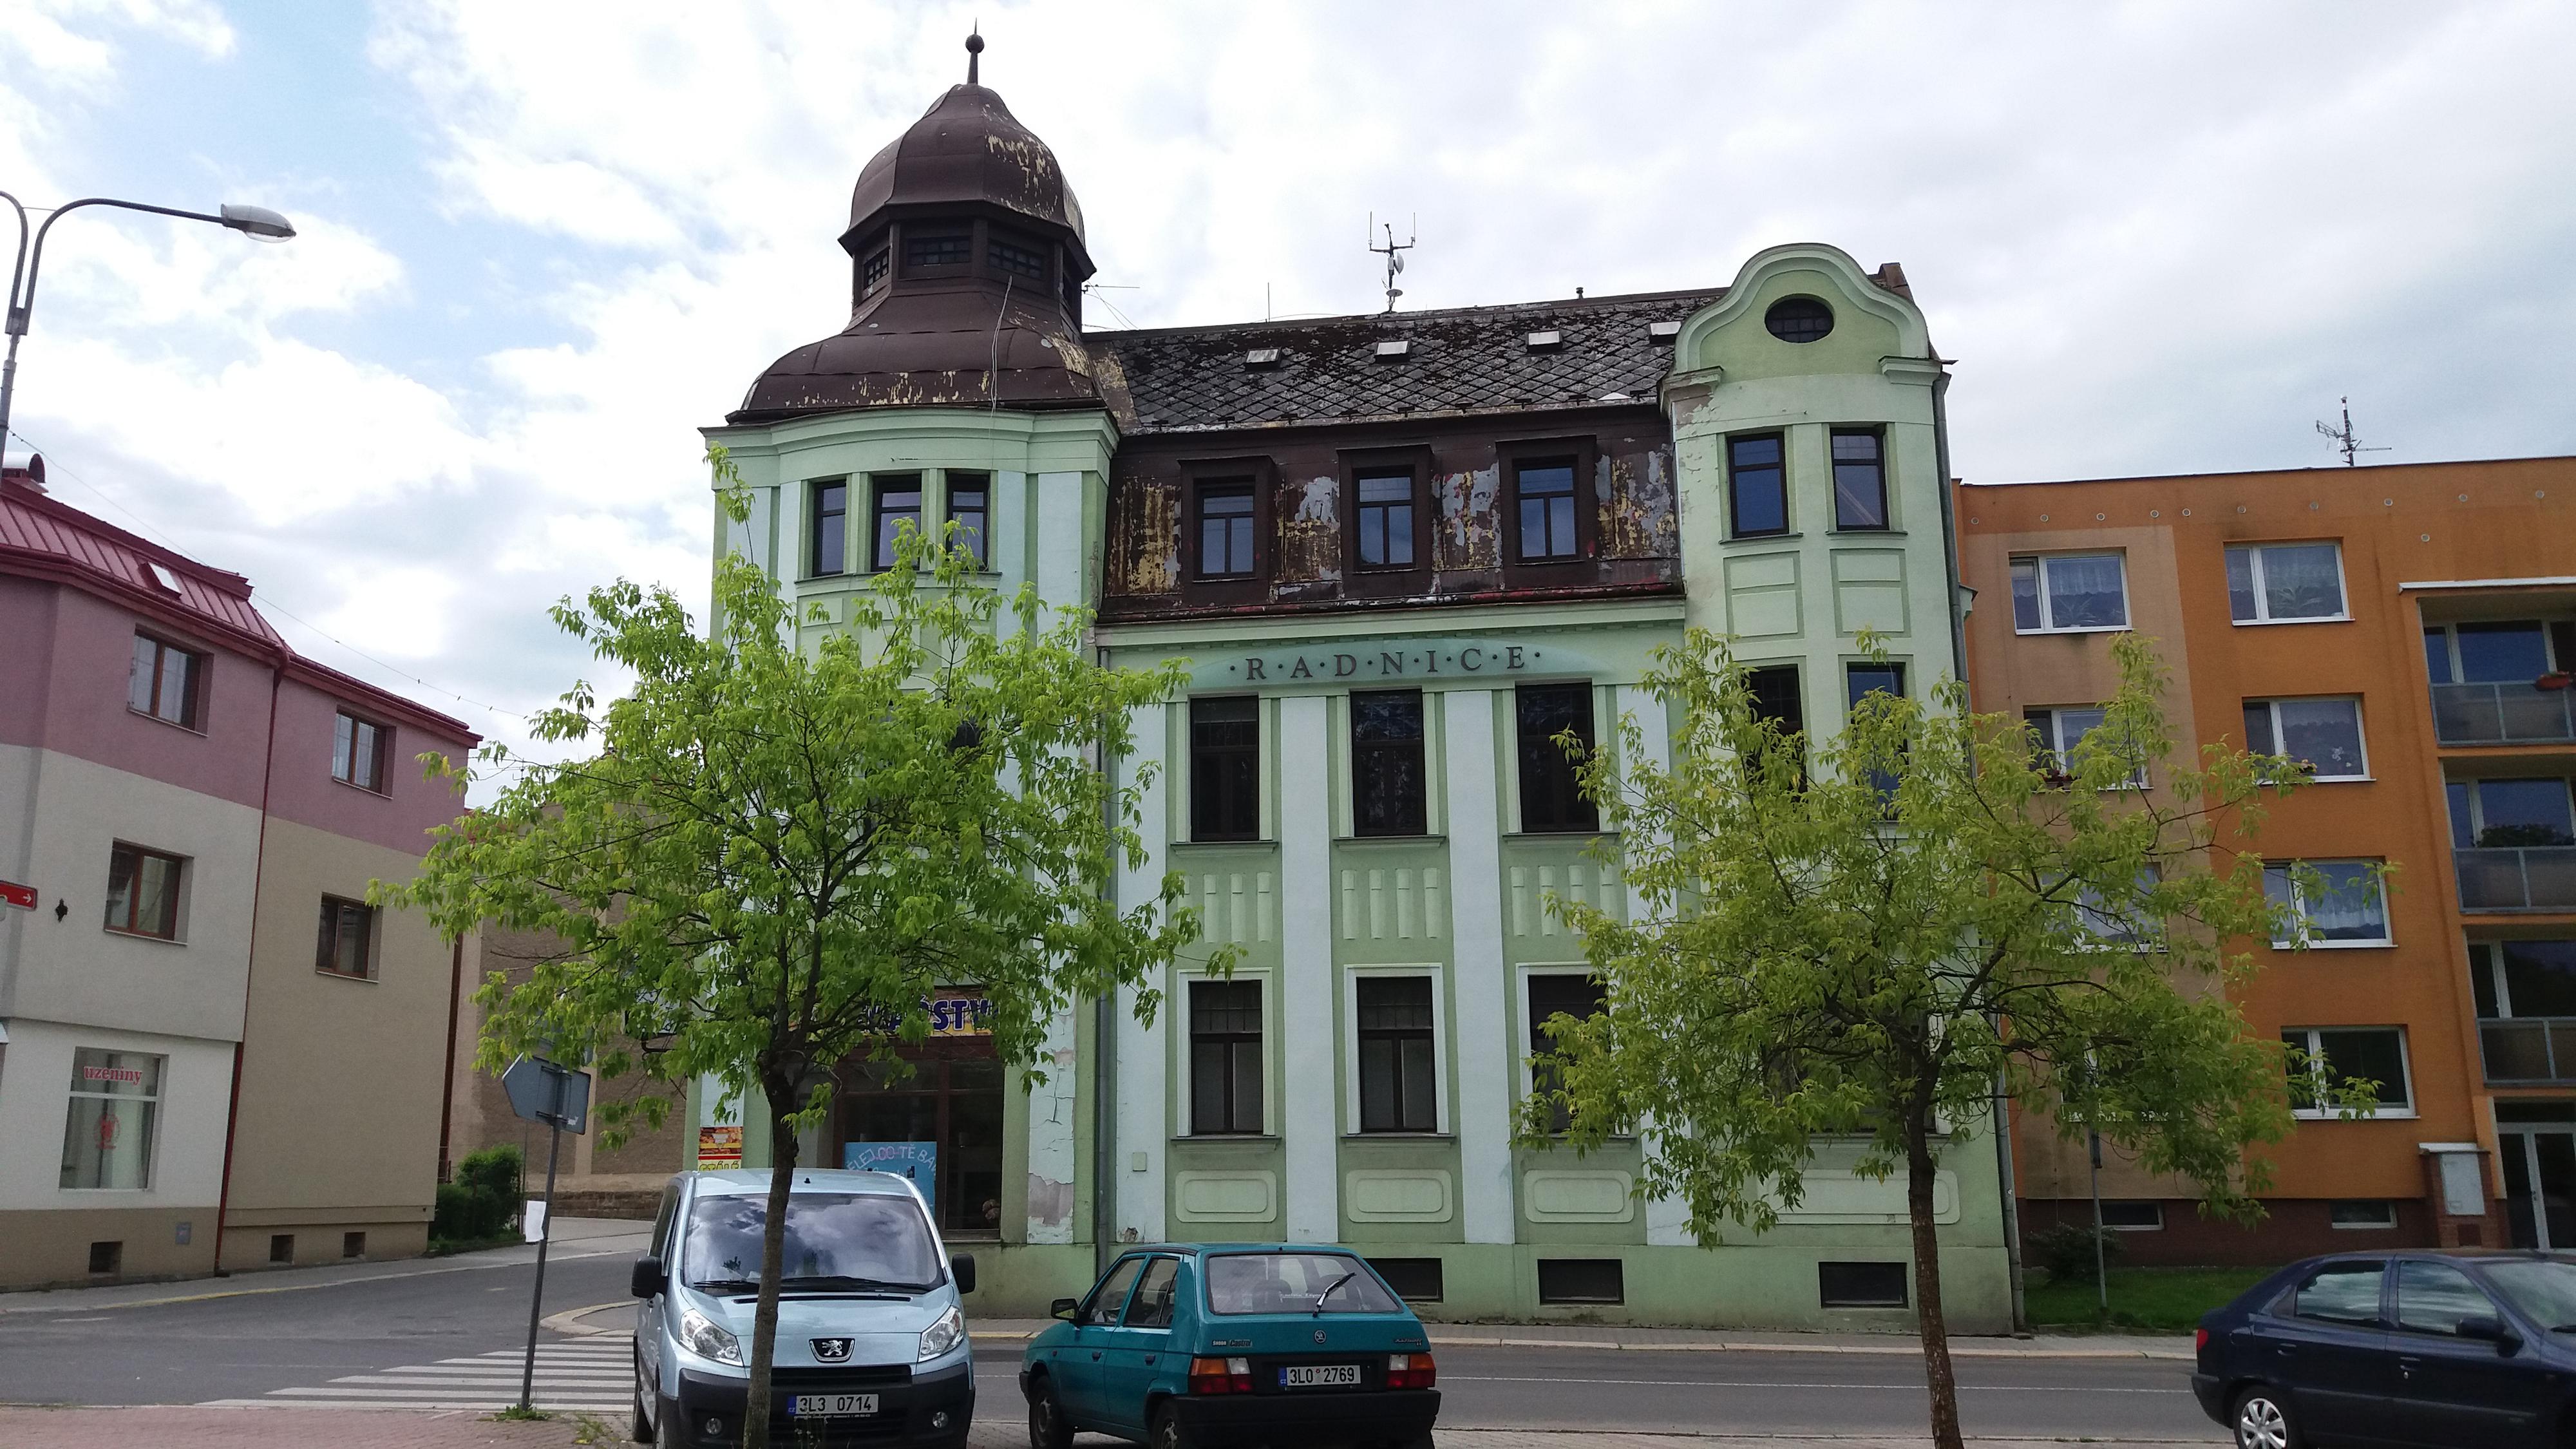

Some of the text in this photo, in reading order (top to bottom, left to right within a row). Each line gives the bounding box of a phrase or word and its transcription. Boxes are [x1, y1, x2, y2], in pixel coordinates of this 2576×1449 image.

[84, 1066, 142, 1086] uzeniny
[1290, 1367, 1354, 1383] 3L0 2769
[799, 1396, 871, 1412] 3L3 0714
